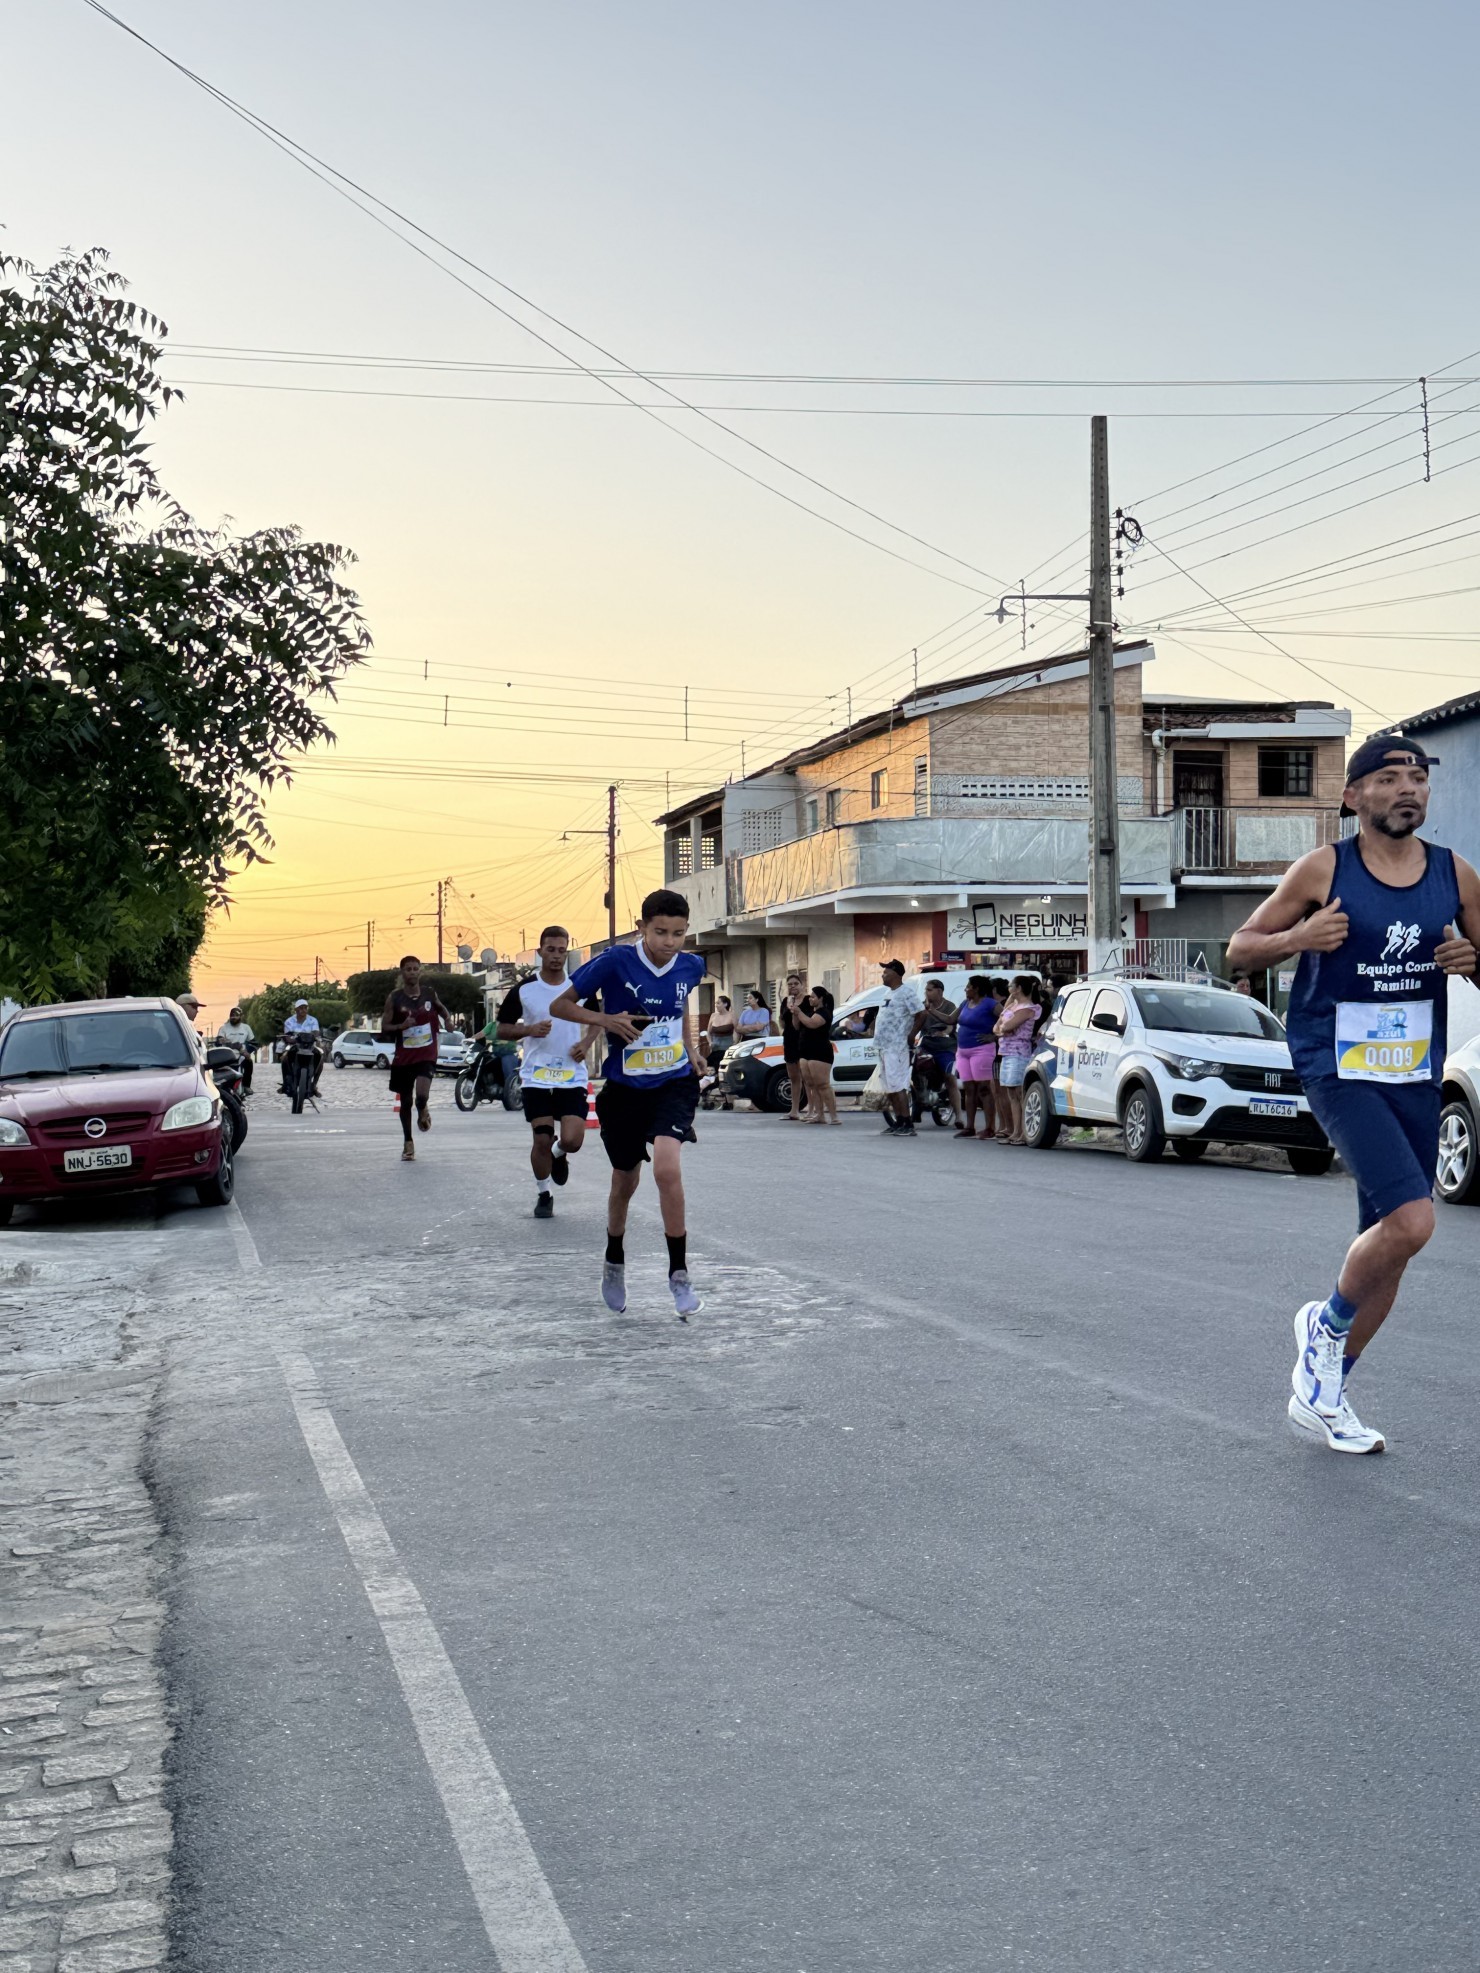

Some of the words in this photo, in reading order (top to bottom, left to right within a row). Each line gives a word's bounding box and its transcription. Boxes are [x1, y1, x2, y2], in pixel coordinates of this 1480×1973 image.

[999, 913, 1088, 927] NEGUINH
[999, 927, 1088, 937] CELULA
[1357, 963, 1403, 977] Equipe
[1405, 961, 1437, 973] Corr
[643, 1049, 674, 1064] 0130
[1365, 1046, 1413, 1067] 0009
[1264, 1072, 1282, 1088] FIAT
